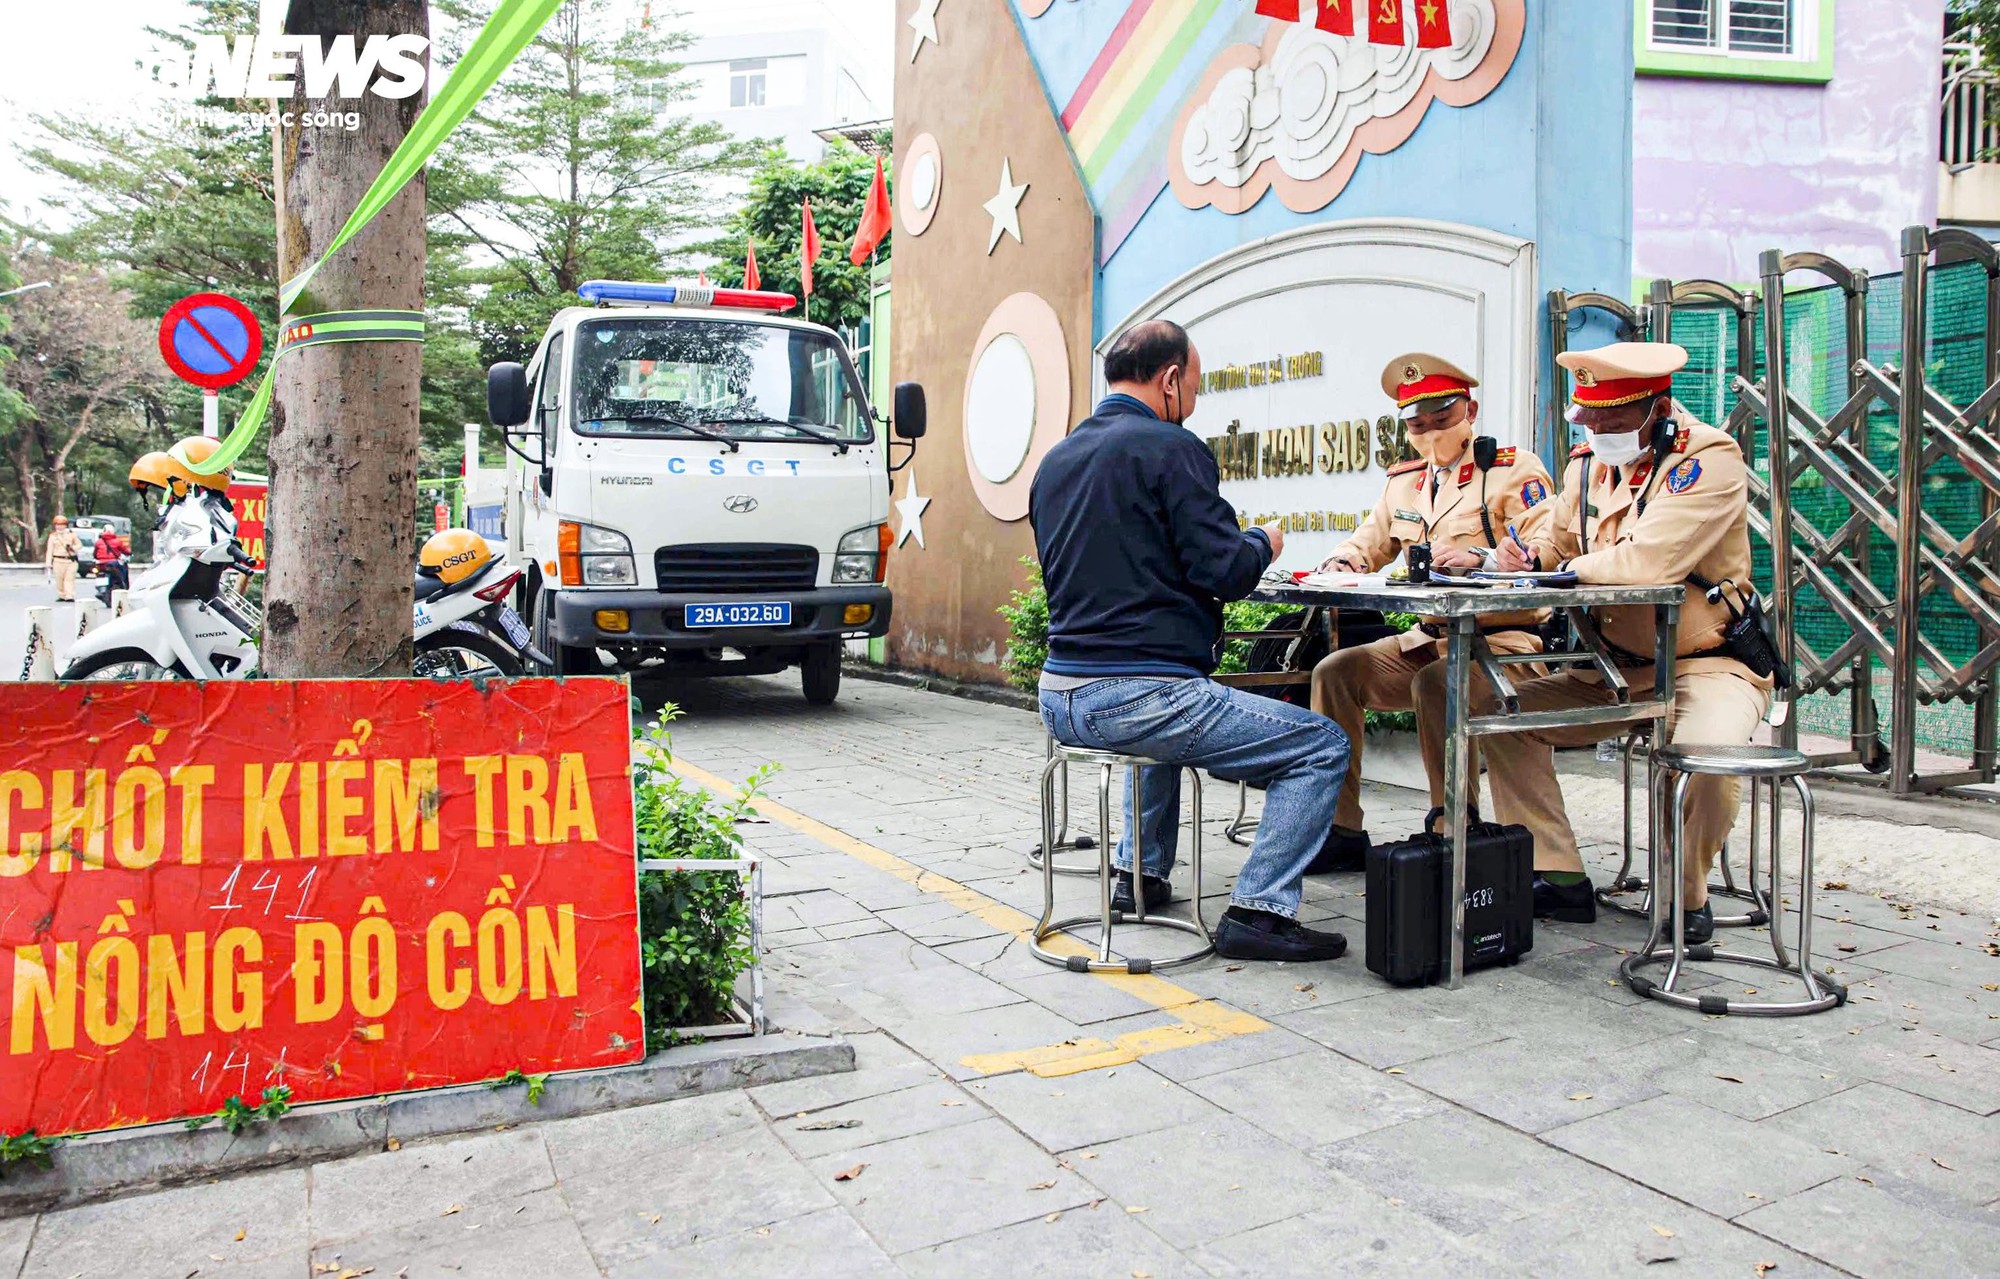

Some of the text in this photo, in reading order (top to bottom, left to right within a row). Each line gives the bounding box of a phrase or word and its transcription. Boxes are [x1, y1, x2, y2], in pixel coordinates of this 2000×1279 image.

[1249, 361, 1267, 387] HAI
[1262, 425, 1315, 478] NON
[1318, 418, 1371, 473] SAO
[601, 476, 653, 485] HYUNDAI
[1291, 511, 1308, 532] Hai
[442, 550, 477, 569] CSGT
[412, 615, 433, 629] OLICE
[694, 606, 783, 624] 29A-032.60
[195, 631, 228, 639] HONDA
[0, 718, 599, 879] CHỐT KIỂM TRA
[10, 874, 579, 1056] NỒNG ĐỘ CỒN
